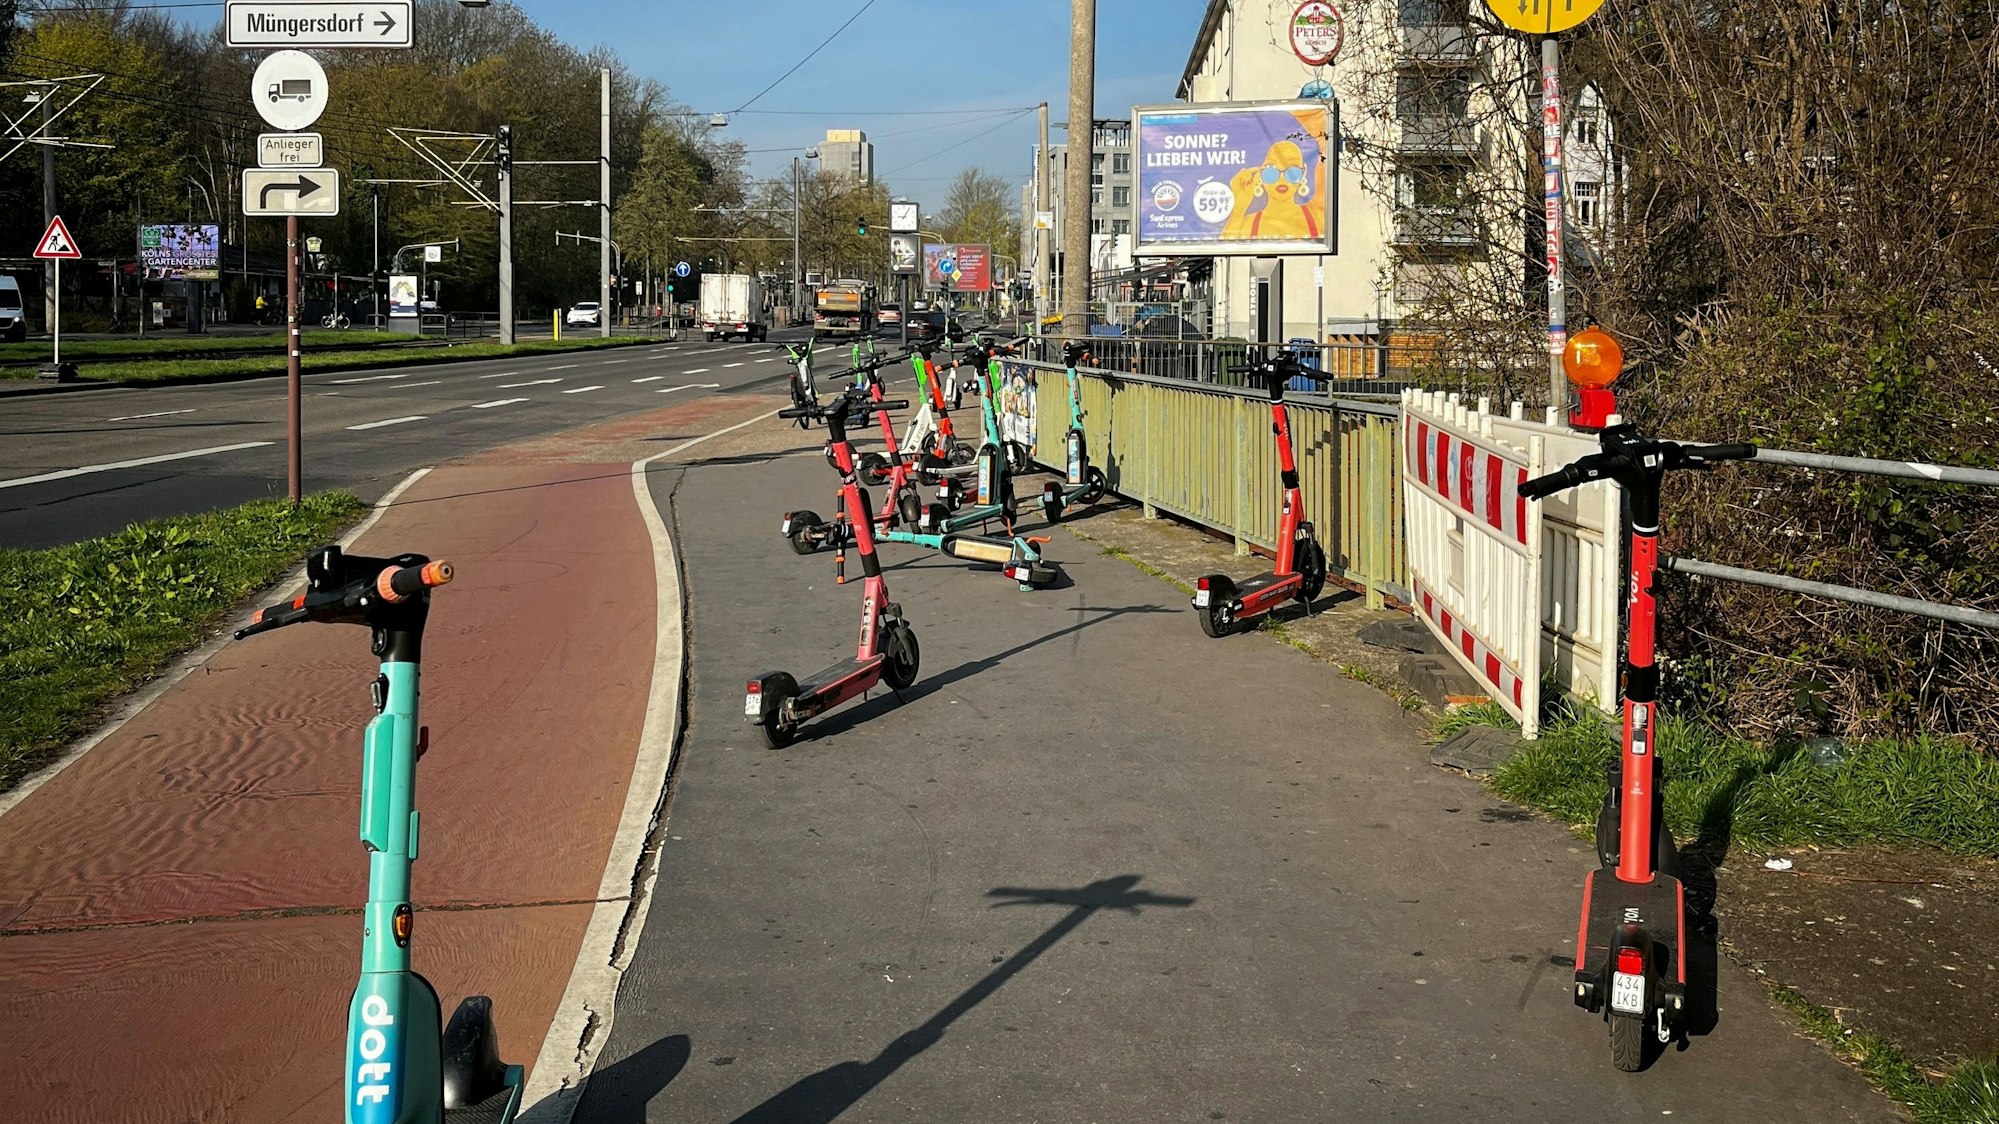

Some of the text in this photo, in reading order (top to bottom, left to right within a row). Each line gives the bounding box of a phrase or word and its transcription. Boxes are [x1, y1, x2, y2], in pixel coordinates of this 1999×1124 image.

[247, 13, 364, 37] Müngersdorf
[1295, 26, 1337, 37] PETERS
[265, 139, 314, 151] Anlieger
[1164, 133, 1229, 149] SONNE?
[280, 152, 300, 163] frei
[1147, 150, 1246, 167] LIEBEN WIR!
[1149, 214, 1184, 223] SunExpress
[147, 257, 216, 266] GARTENCENTER
[1616, 976, 1640, 990] 434
[1616, 992, 1639, 1007] IKB
[356, 994, 394, 1106] dott
